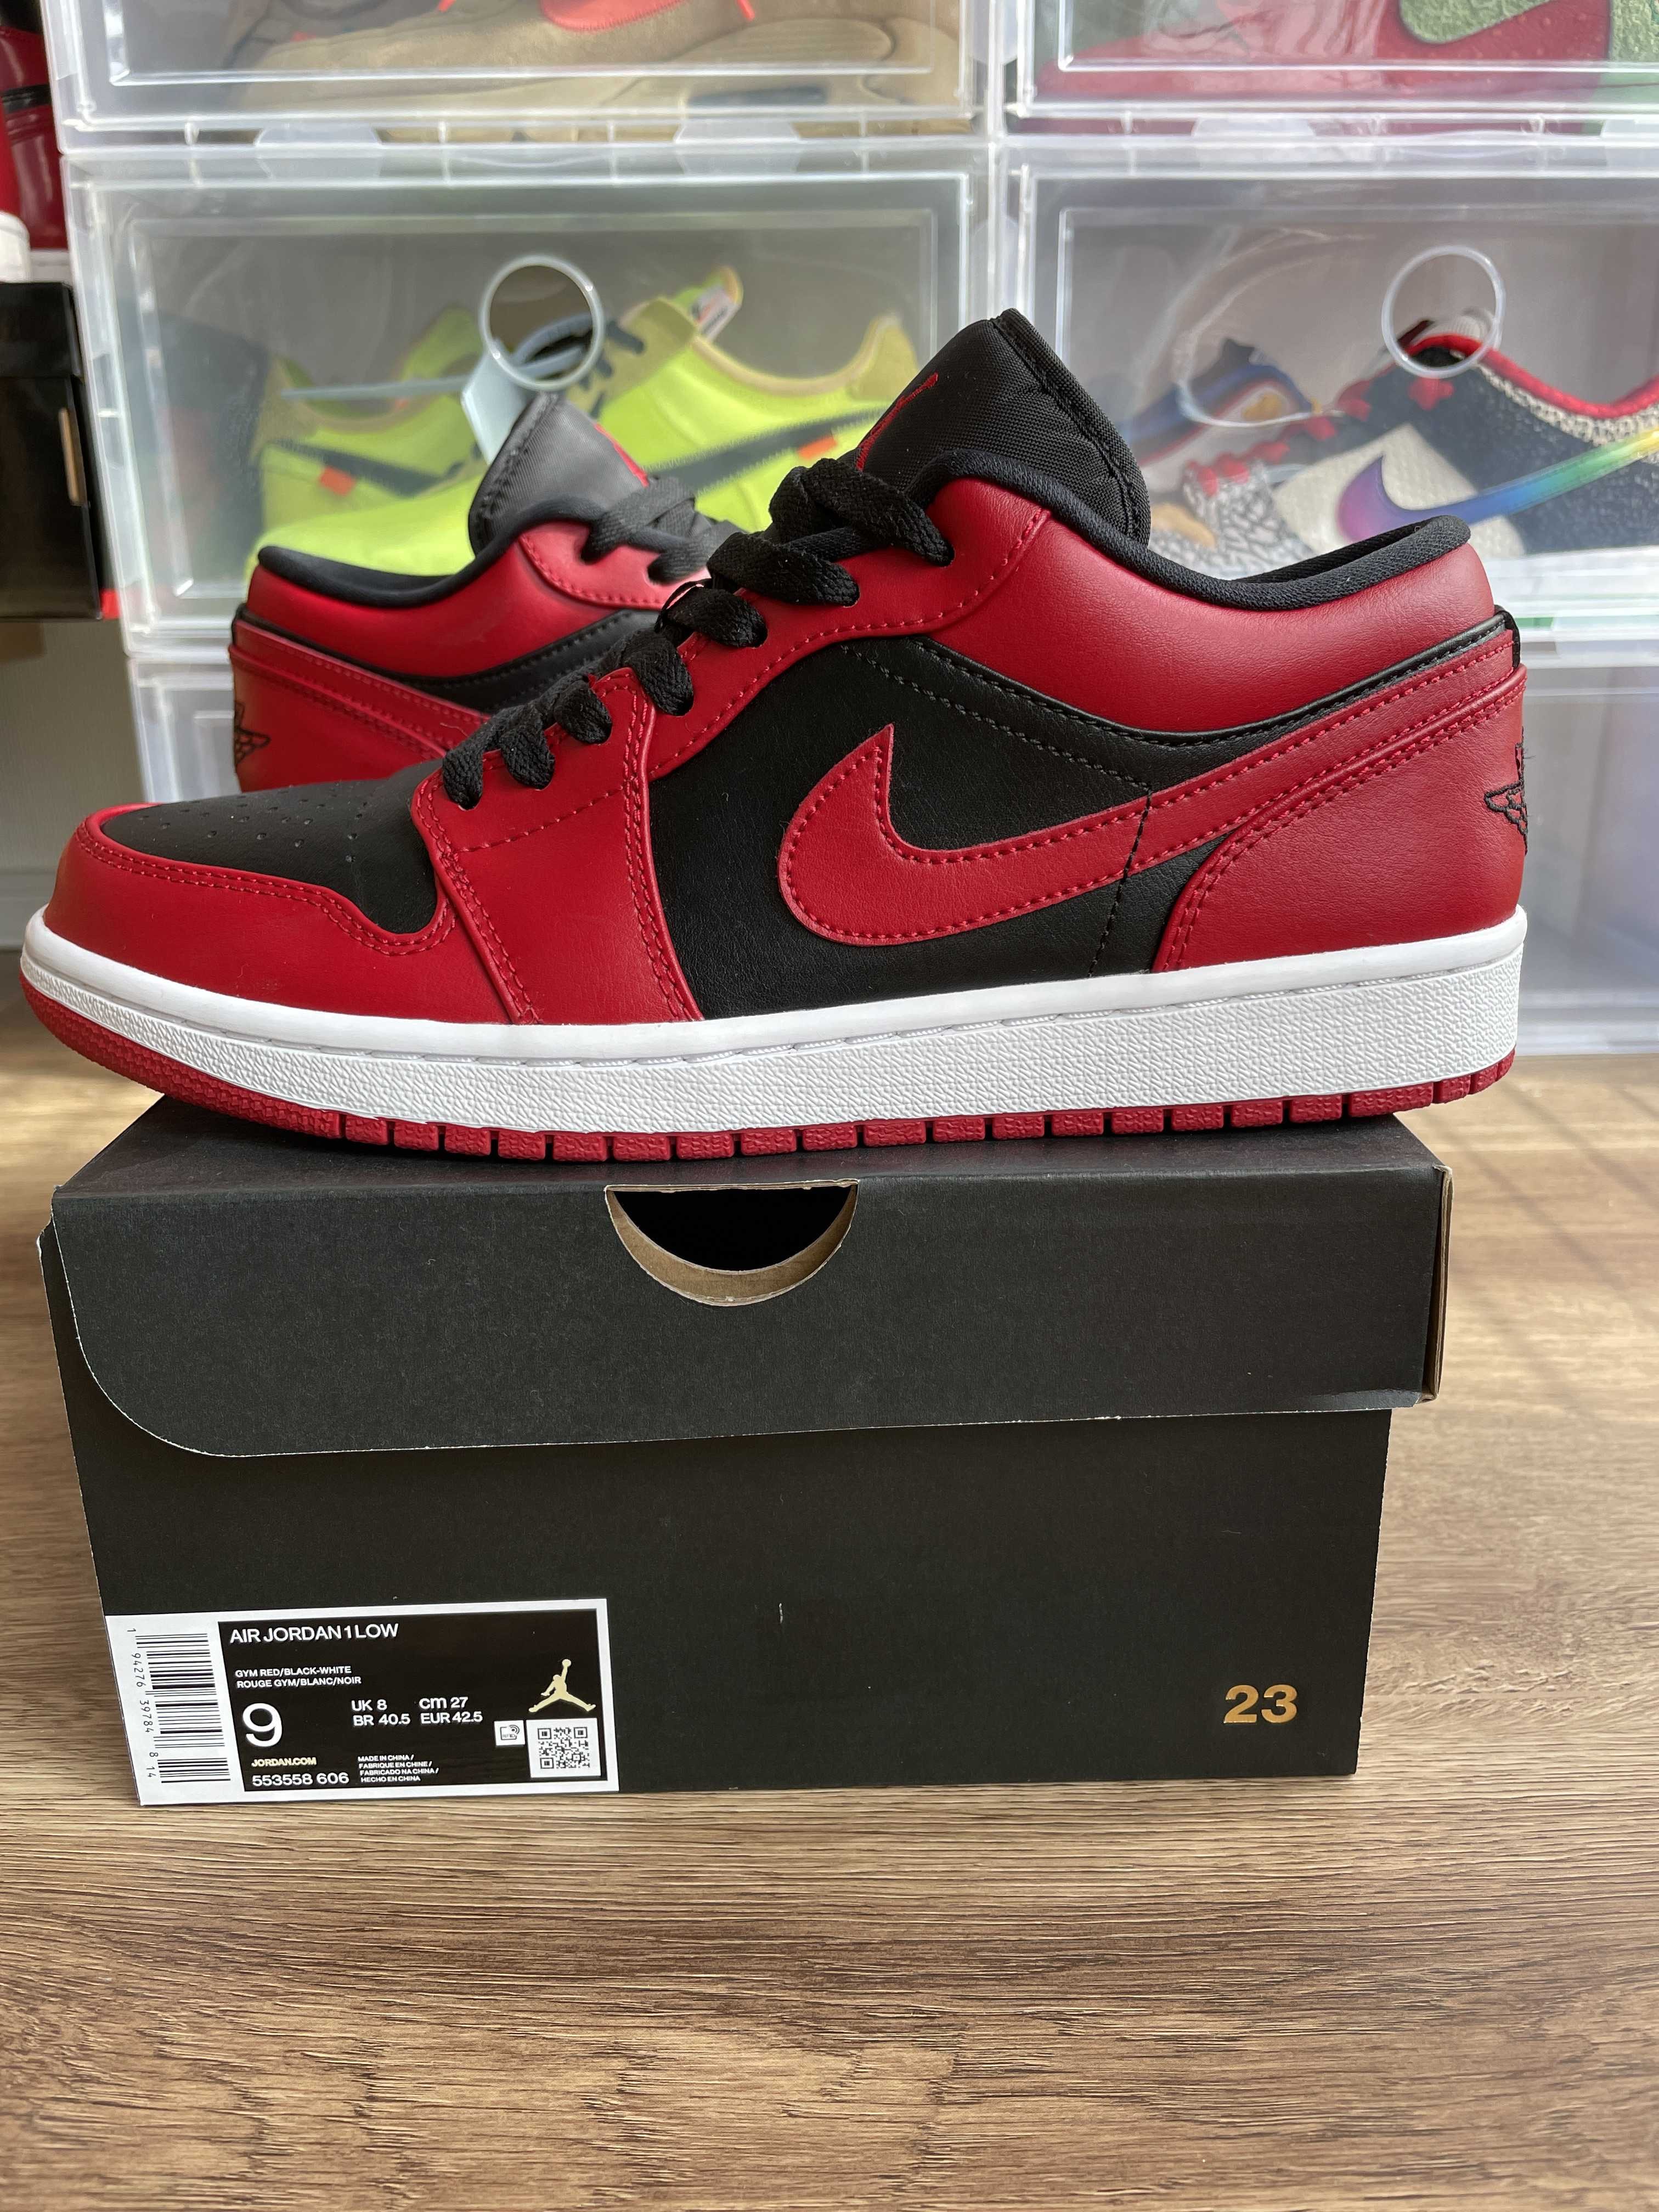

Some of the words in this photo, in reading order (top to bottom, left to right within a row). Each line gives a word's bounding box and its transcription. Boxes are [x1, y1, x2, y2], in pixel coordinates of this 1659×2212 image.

[230, 1628, 261, 1643] AIR
[263, 1625, 342, 1642] JORDAN
[344, 1626, 352, 1638] 1
[355, 1623, 399, 1638] LOW
[132, 1653, 146, 1688] 94276
[235, 1669, 258, 1678] GYM
[260, 1666, 352, 1677] RED/BLACK-WHITE
[236, 1680, 272, 1689] ROUGE
[274, 1676, 362, 1687] GYM/BLANC/NOIR
[351, 1700, 373, 1711] UK
[377, 1699, 387, 1711] 8
[450, 1696, 469, 1708] 27
[1223, 1684, 1297, 1723] 23
[140, 1700, 154, 1733] 39784
[353, 1714, 374, 1726] BR
[379, 1713, 411, 1725] 40.5
[420, 1712, 450, 1724] EUR
[452, 1711, 483, 1723] 42.5
[242, 1702, 283, 1747] 9
[251, 1757, 317, 1767] JORDAN.COM
[146, 1766, 156, 1778] 14
[252, 1773, 313, 1787] 553558
[316, 1772, 349, 1785] 606
